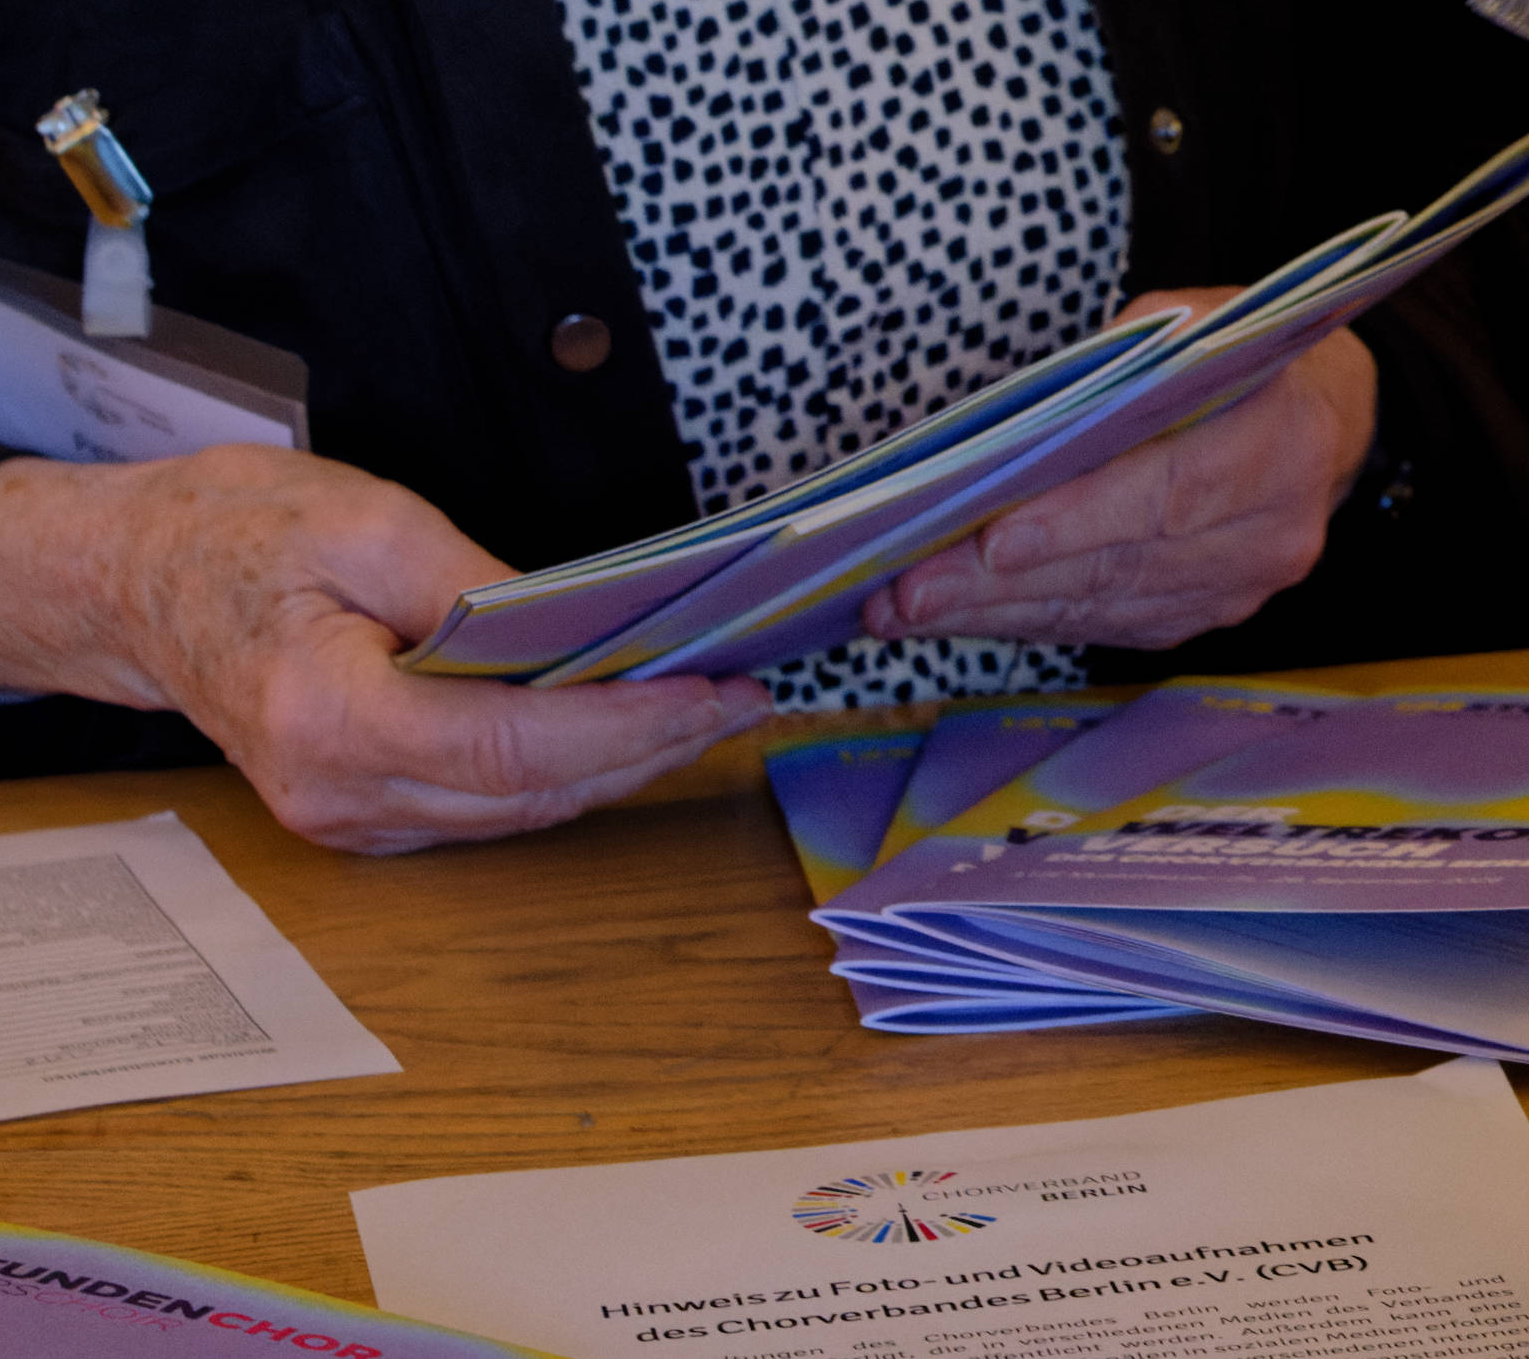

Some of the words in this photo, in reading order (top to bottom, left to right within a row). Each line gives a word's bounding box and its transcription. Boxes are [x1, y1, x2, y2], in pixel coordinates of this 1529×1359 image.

[1079, 835, 1454, 858] VERSUCH
[921, 1170, 1142, 1203] CHORVERBAND
[1042, 1183, 1148, 1203] BERLIN
[600, 1289, 768, 1320] Hinweis
[773, 1285, 821, 1304] zu
[830, 1276, 937, 1297] Foto-
[945, 1265, 1022, 1285] und
[1027, 1232, 1376, 1281] Videoaufnahmen
[635, 1323, 709, 1343] des
[716, 1292, 1032, 1336] Chorverbandes
[1039, 1274, 1162, 1303] Berlin
[1169, 1268, 1245, 1288] e.V.
[1256, 1254, 1371, 1282] (CVB)
[852, 1339, 897, 1351] des
[924, 1317, 1117, 1343] Chorverbandes
[1144, 1303, 1220, 1321] Berlin
[1246, 1293, 1340, 1309] werden
[1366, 1283, 1432, 1297] Foto-
[1457, 1274, 1506, 1288] und
[928, 1344, 967, 1356] die
[982, 1340, 1006, 1350] in
[1018, 1320, 1205, 1346] verschiedenen
[1219, 1309, 1313, 1326] Medien
[1326, 1304, 1370, 1316] des
[1380, 1288, 1514, 1309] Verbandes
[1241, 1317, 1373, 1337] Außerdem
[1389, 1308, 1452, 1322] kann
[1470, 1300, 1522, 1314] eine
[1183, 1346, 1209, 1357] in
[1214, 1335, 1320, 1352] sozialen
[1325, 1324, 1420, 1342] Medien
